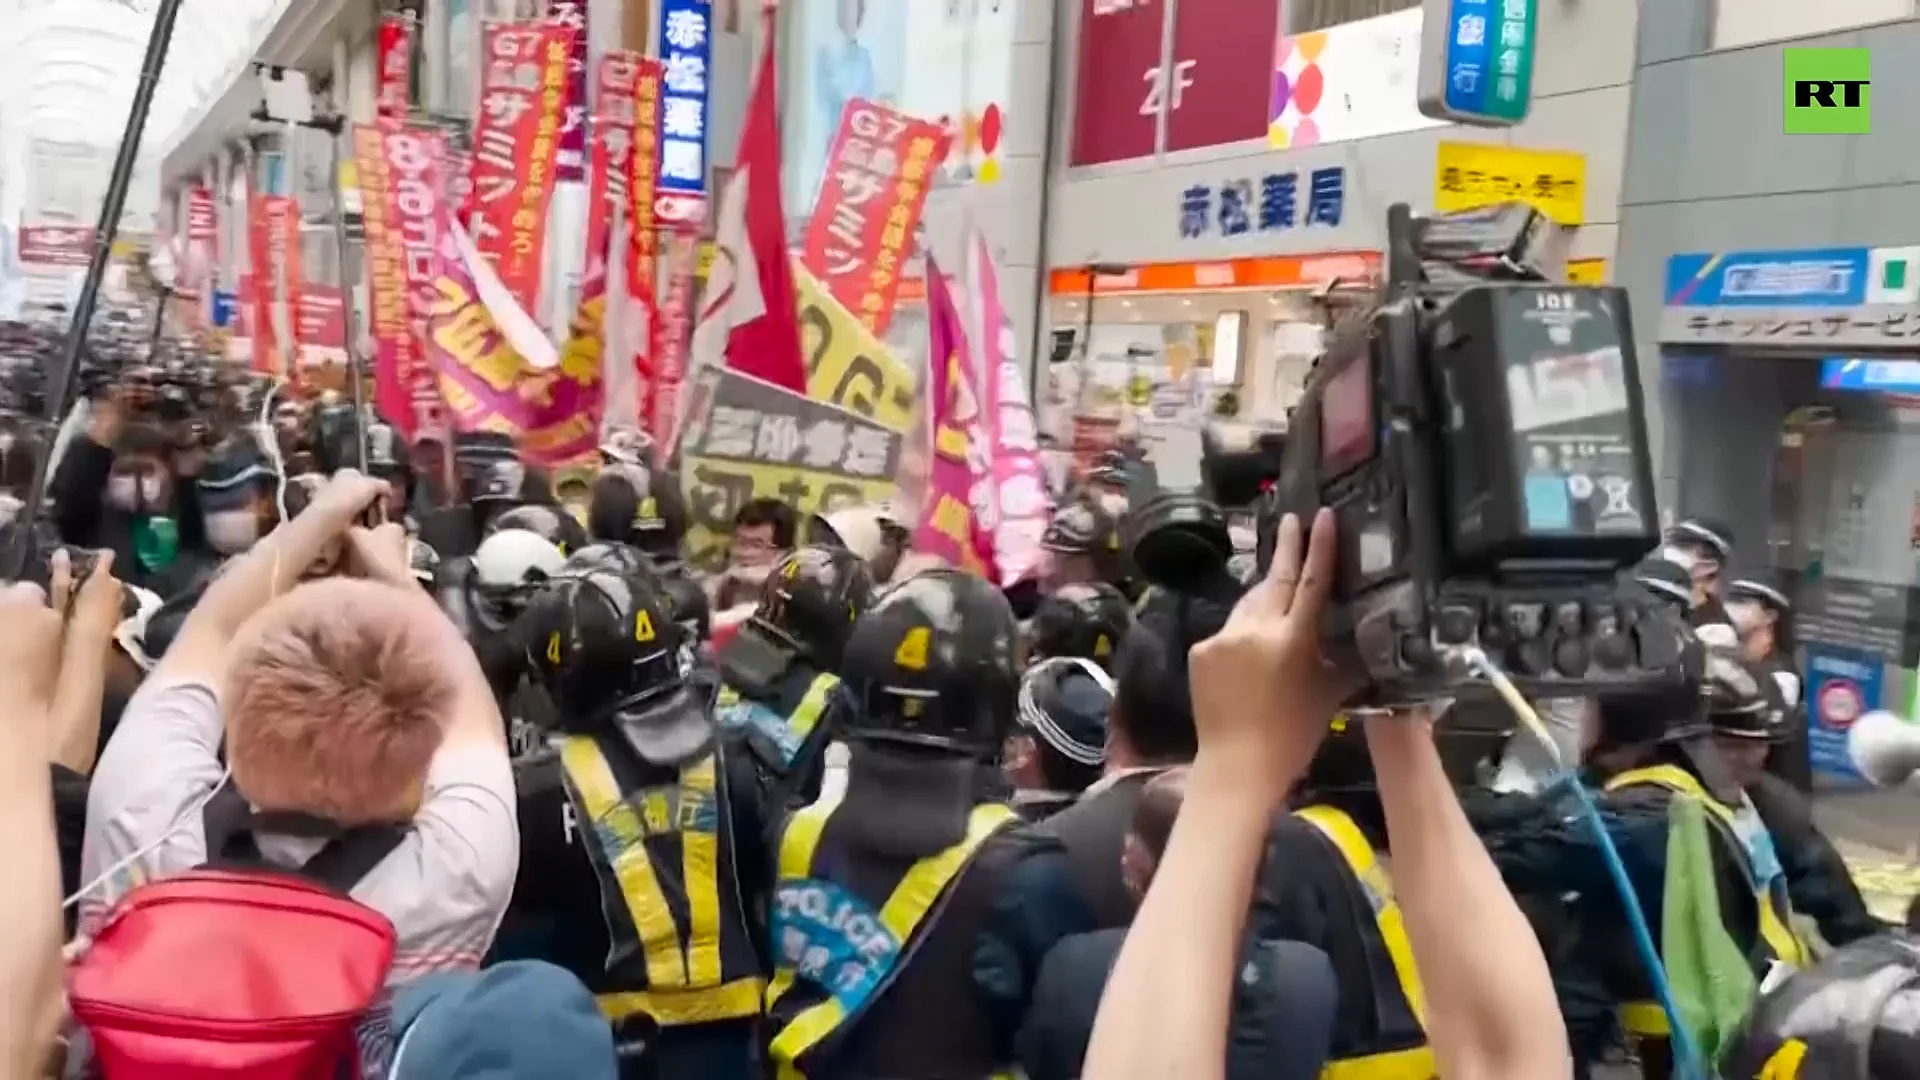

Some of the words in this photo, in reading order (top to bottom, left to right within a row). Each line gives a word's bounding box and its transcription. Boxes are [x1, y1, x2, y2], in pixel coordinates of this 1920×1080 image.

[1453, 0, 1487, 94] 銀行
[1139, 59, 1197, 115] 2F
[895, 626, 932, 670] 4
